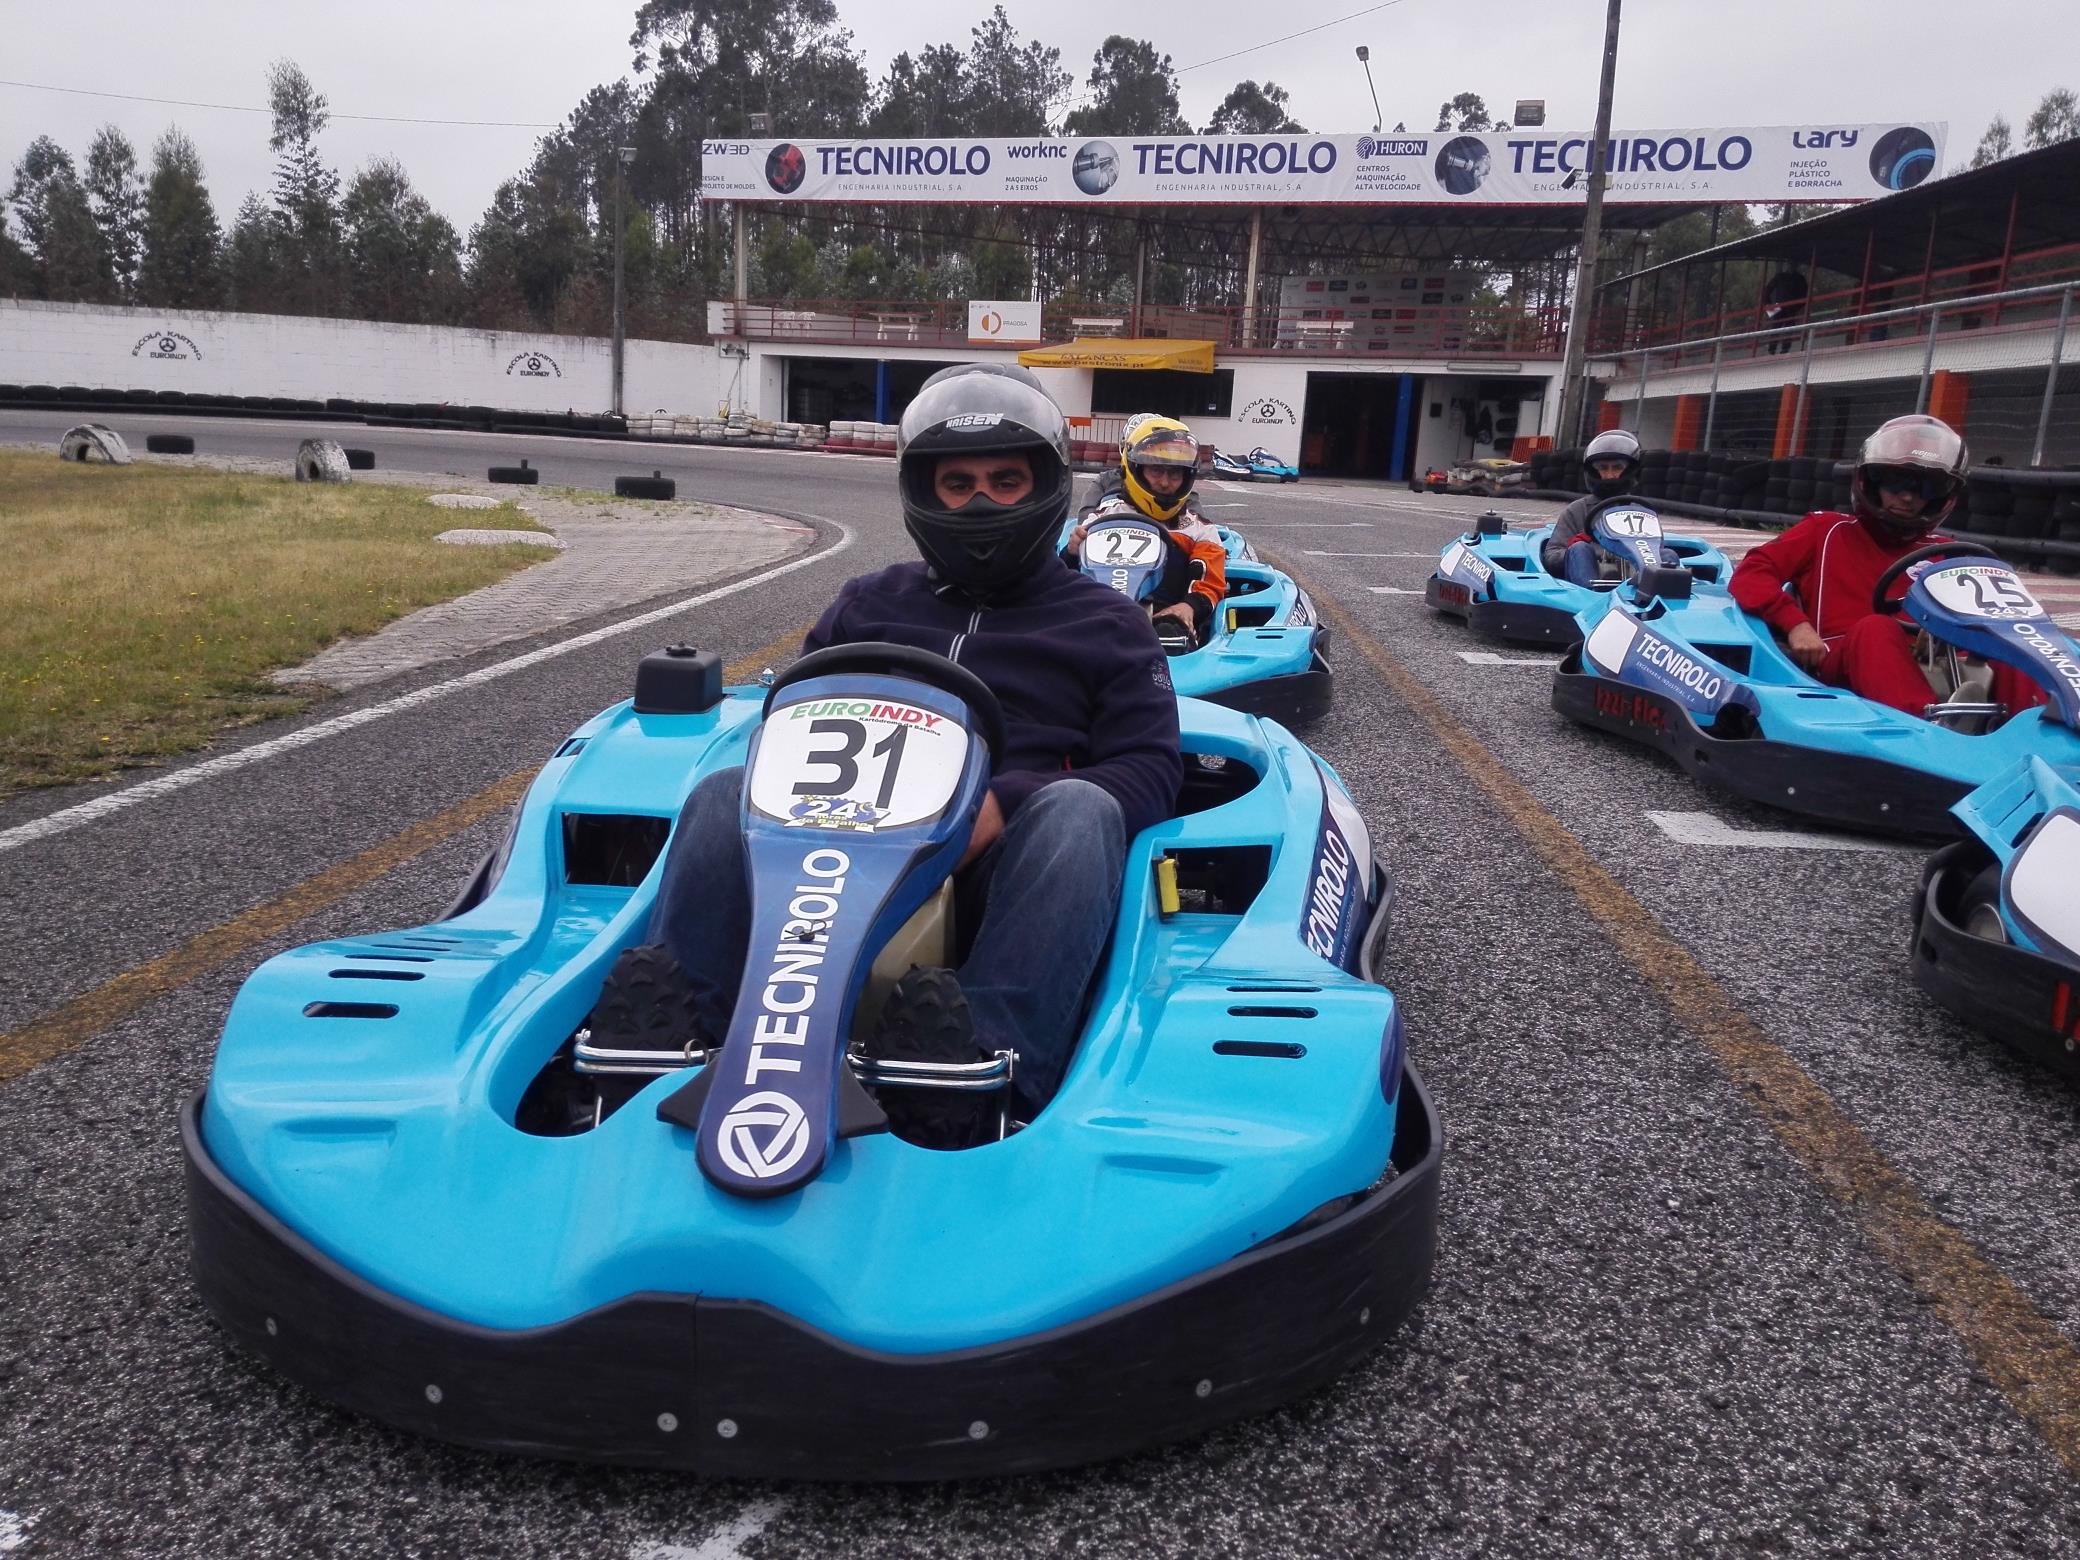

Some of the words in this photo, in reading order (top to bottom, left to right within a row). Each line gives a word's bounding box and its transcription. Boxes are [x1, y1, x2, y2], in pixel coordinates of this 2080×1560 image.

[702, 143, 750, 155] ZW3D
[1006, 140, 1068, 158] worknc
[1380, 142, 1424, 154] HURON
[816, 145, 991, 176] TECNIROLO
[1132, 141, 1337, 174] TECNIROLO
[1790, 160, 1827, 169] INJEÇÃO
[1005, 174, 1048, 183] MAQUINAÇÃO
[1356, 173, 1406, 182] MAQUINAÇÃO
[1789, 169, 1831, 178] PLÁSTICO
[893, 183, 945, 192] INDUSTRIAL,
[1155, 183, 1216, 191] ENGENHARIA
[1220, 183, 1282, 192] INDUSTRIAL,
[1375, 183, 1421, 191] VELOCIDADE
[132, 331, 161, 357] ESCOLA
[167, 330, 202, 360] KARTING
[150, 351, 187, 360] EUROINDY
[506, 352, 530, 375] ESCOLA
[533, 351, 562, 377] KARTING
[1238, 398, 1264, 423] ESCOLA
[1268, 397, 1297, 425] KARTING
[1251, 417, 1284, 425] EUROINDY
[1097, 528, 1153, 538] EUROINDY
[1623, 514, 1645, 534] 17
[1106, 532, 1152, 559] 27
[1940, 567, 2010, 580] EUROINDY
[1957, 573, 2034, 609] 25
[1636, 632, 1721, 700] TECNIROLO
[790, 702, 943, 729] EUROINDY
[790, 718, 910, 810] 31
[802, 800, 858, 819] 24
[744, 848, 850, 1085] TECNIROLO
